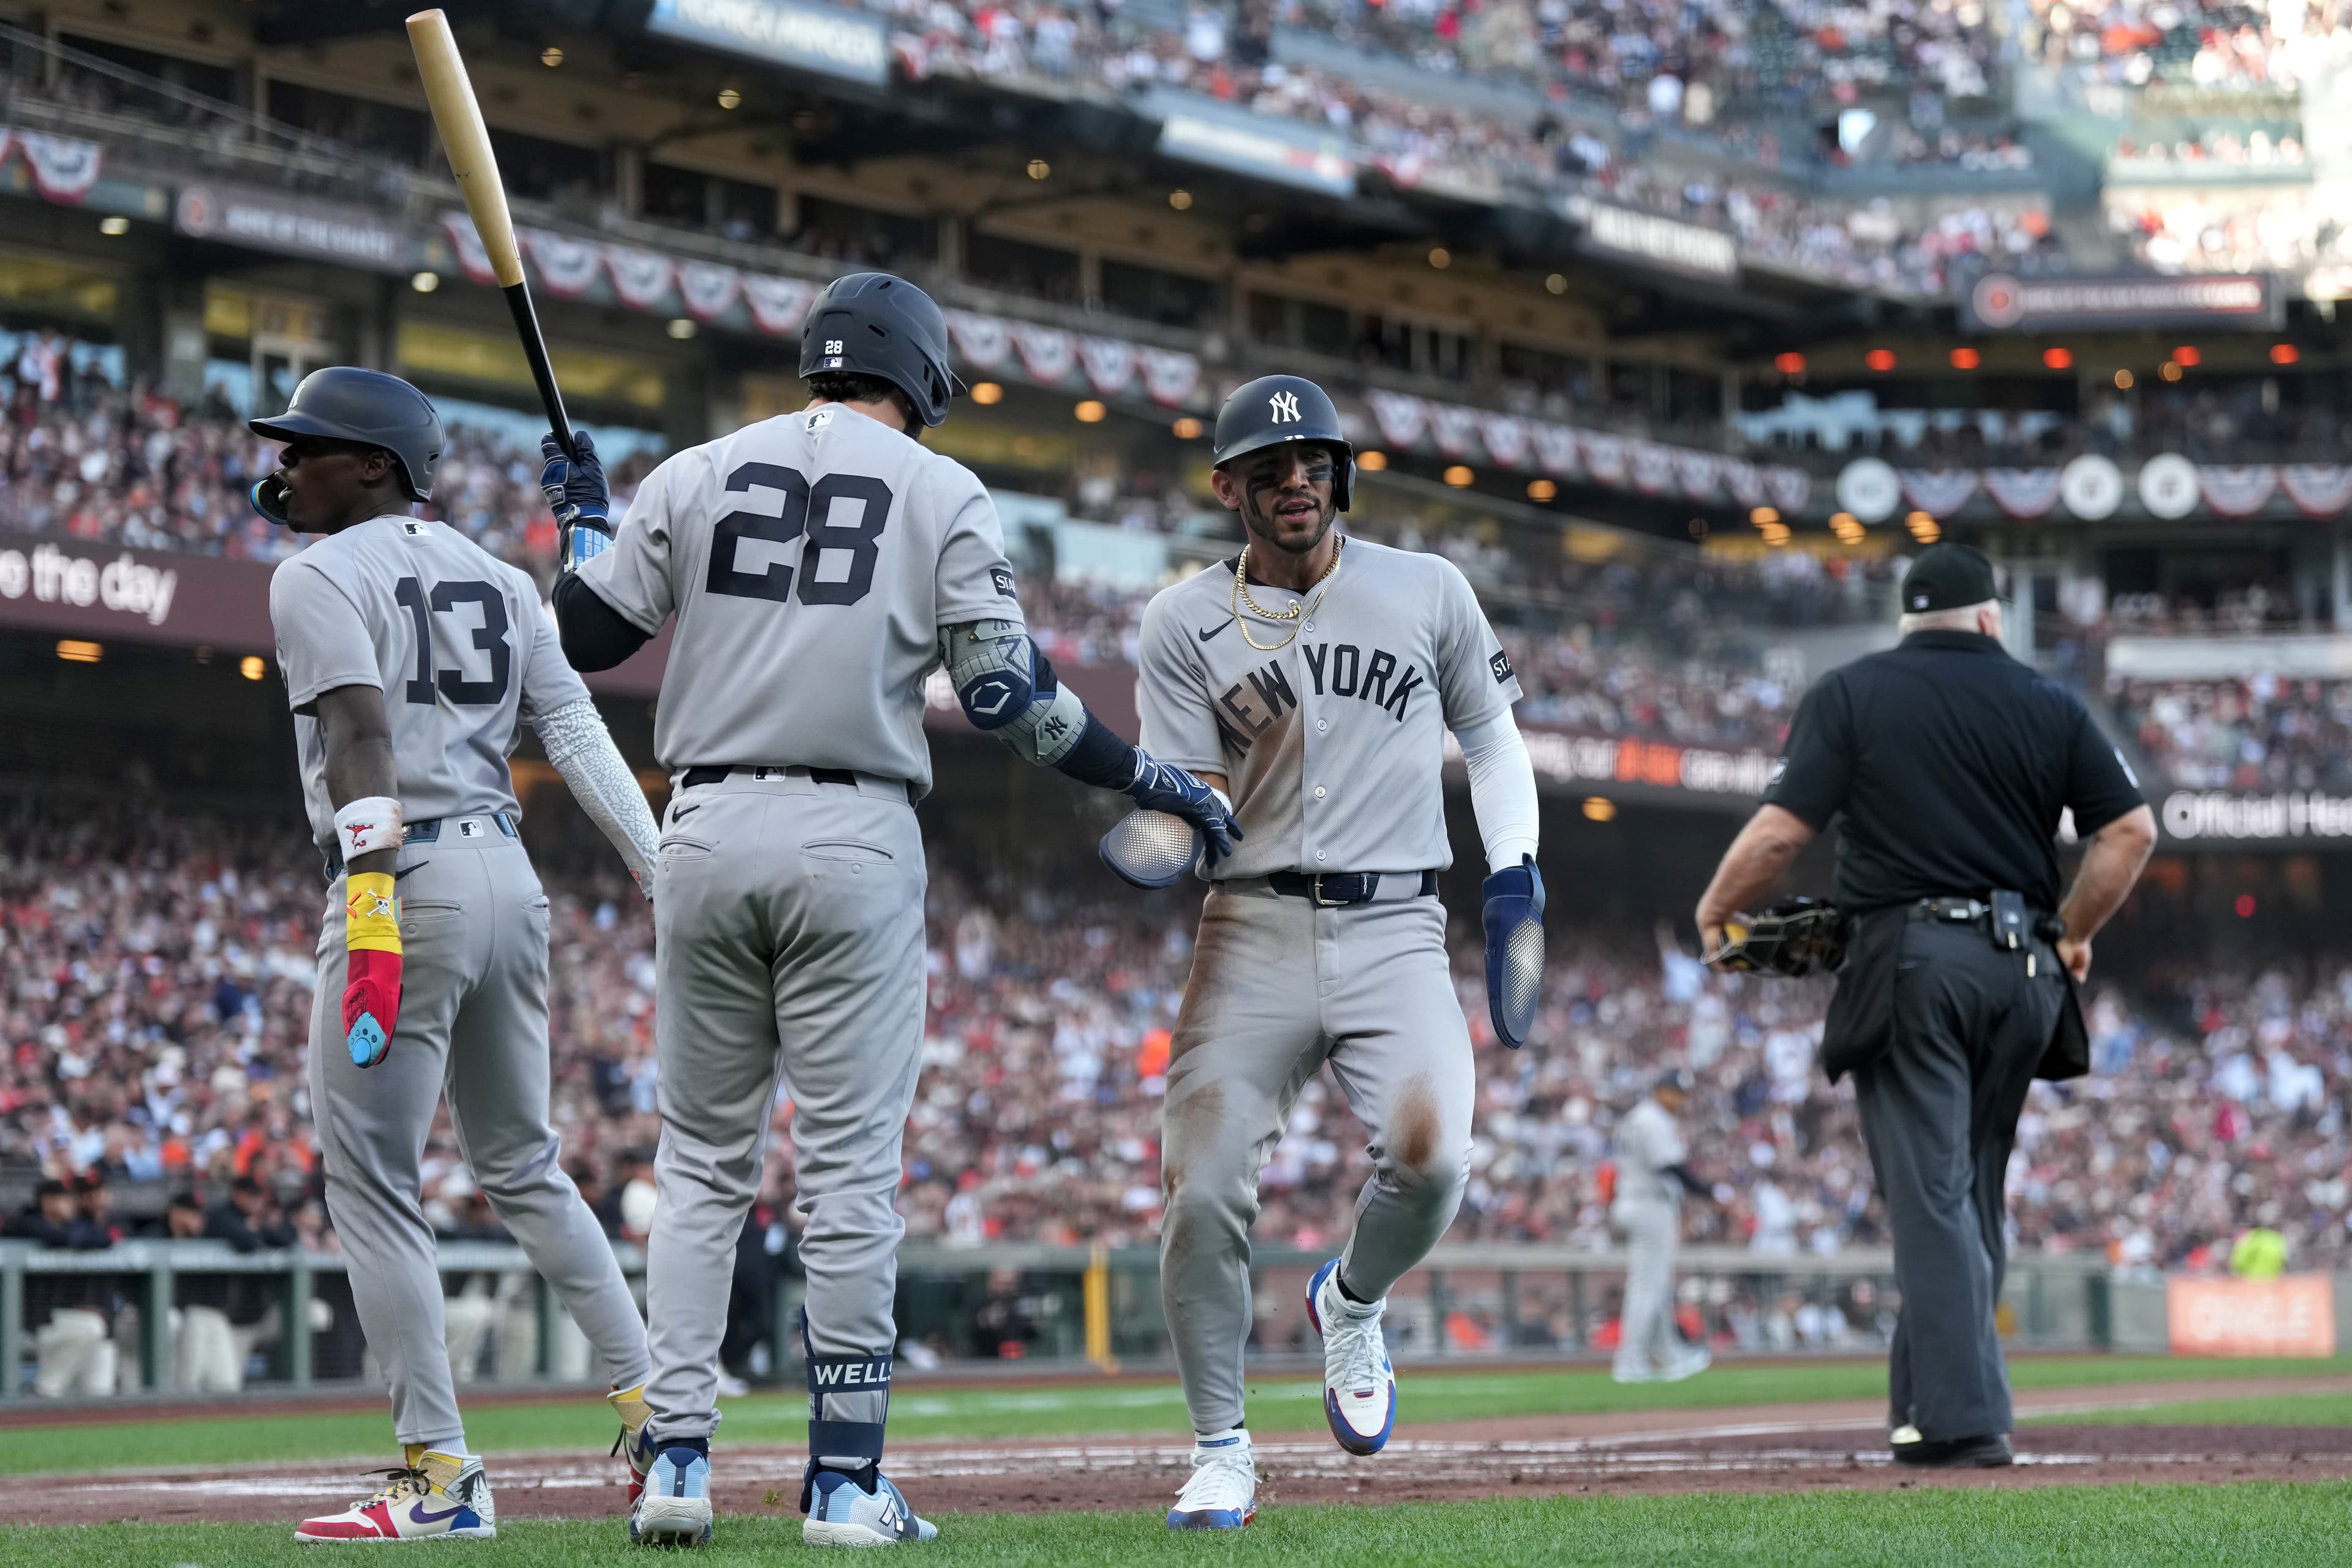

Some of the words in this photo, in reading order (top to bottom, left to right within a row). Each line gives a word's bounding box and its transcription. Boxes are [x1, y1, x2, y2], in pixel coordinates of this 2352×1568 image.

[825, 340, 843, 355] 28
[1268, 390, 1302, 424] NY
[706, 462, 894, 606] 28
[33, 543, 99, 607] the
[100, 553, 178, 625] day
[995, 575, 1016, 593] STA
[394, 576, 511, 706] 13
[1216, 659, 1297, 759] NEW
[1302, 643, 1424, 723] YORK
